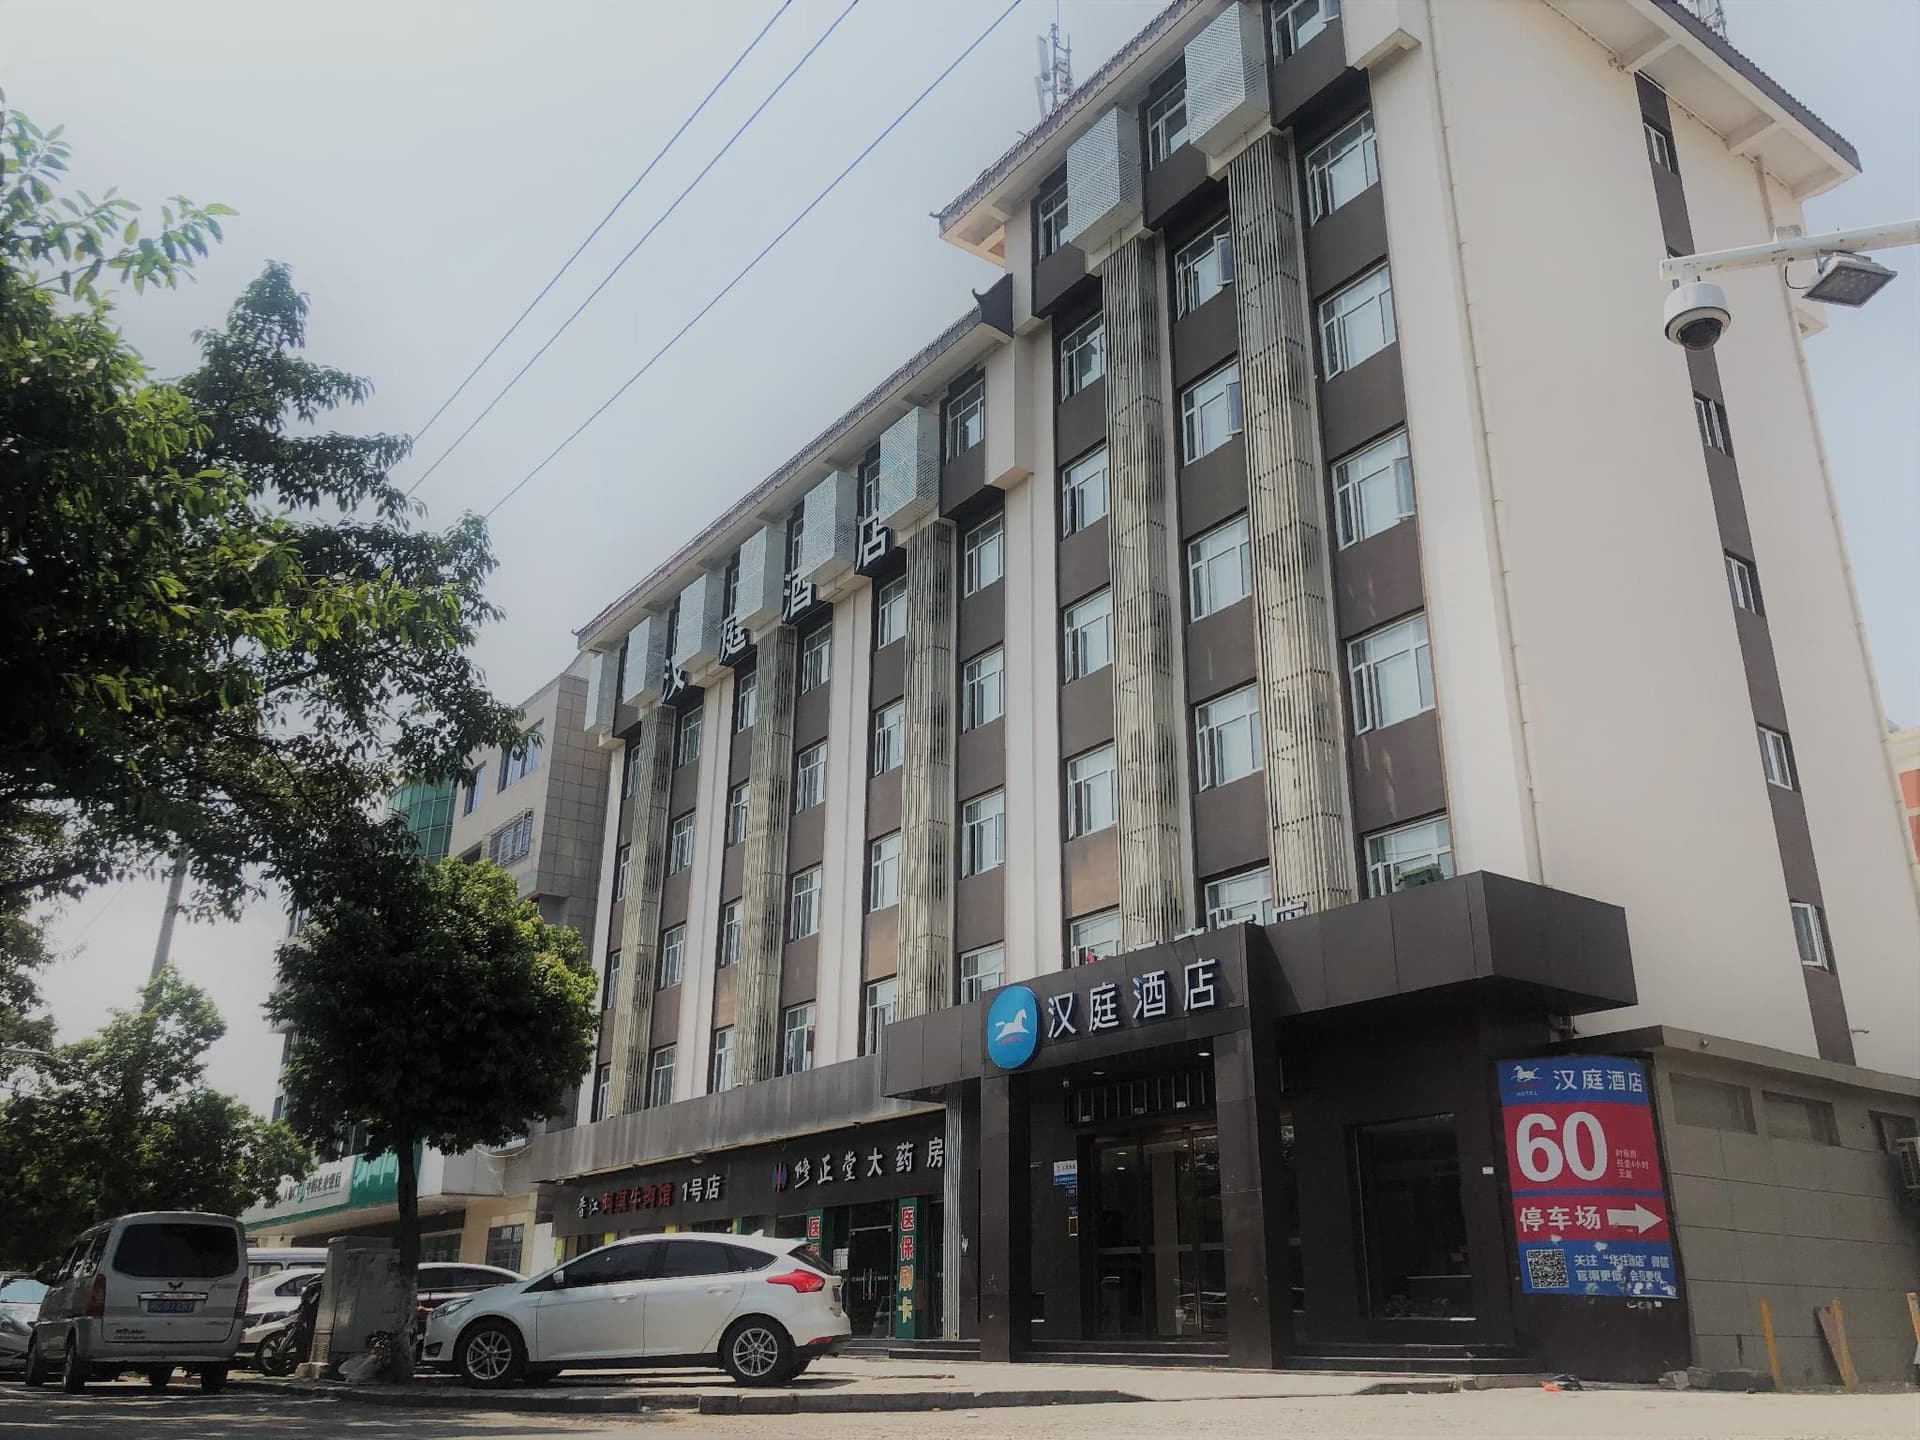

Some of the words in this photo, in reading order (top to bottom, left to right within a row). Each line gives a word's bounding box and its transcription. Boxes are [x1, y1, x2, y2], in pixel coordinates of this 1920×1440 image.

[1047, 958, 1217, 1039] 汉庭酒店
[1553, 1069, 1643, 1093] 汉庭酒店
[794, 1136, 945, 1189] 修正堂大药房
[1516, 1112, 1608, 1182] 60
[1520, 1205, 1602, 1233] 停车场
